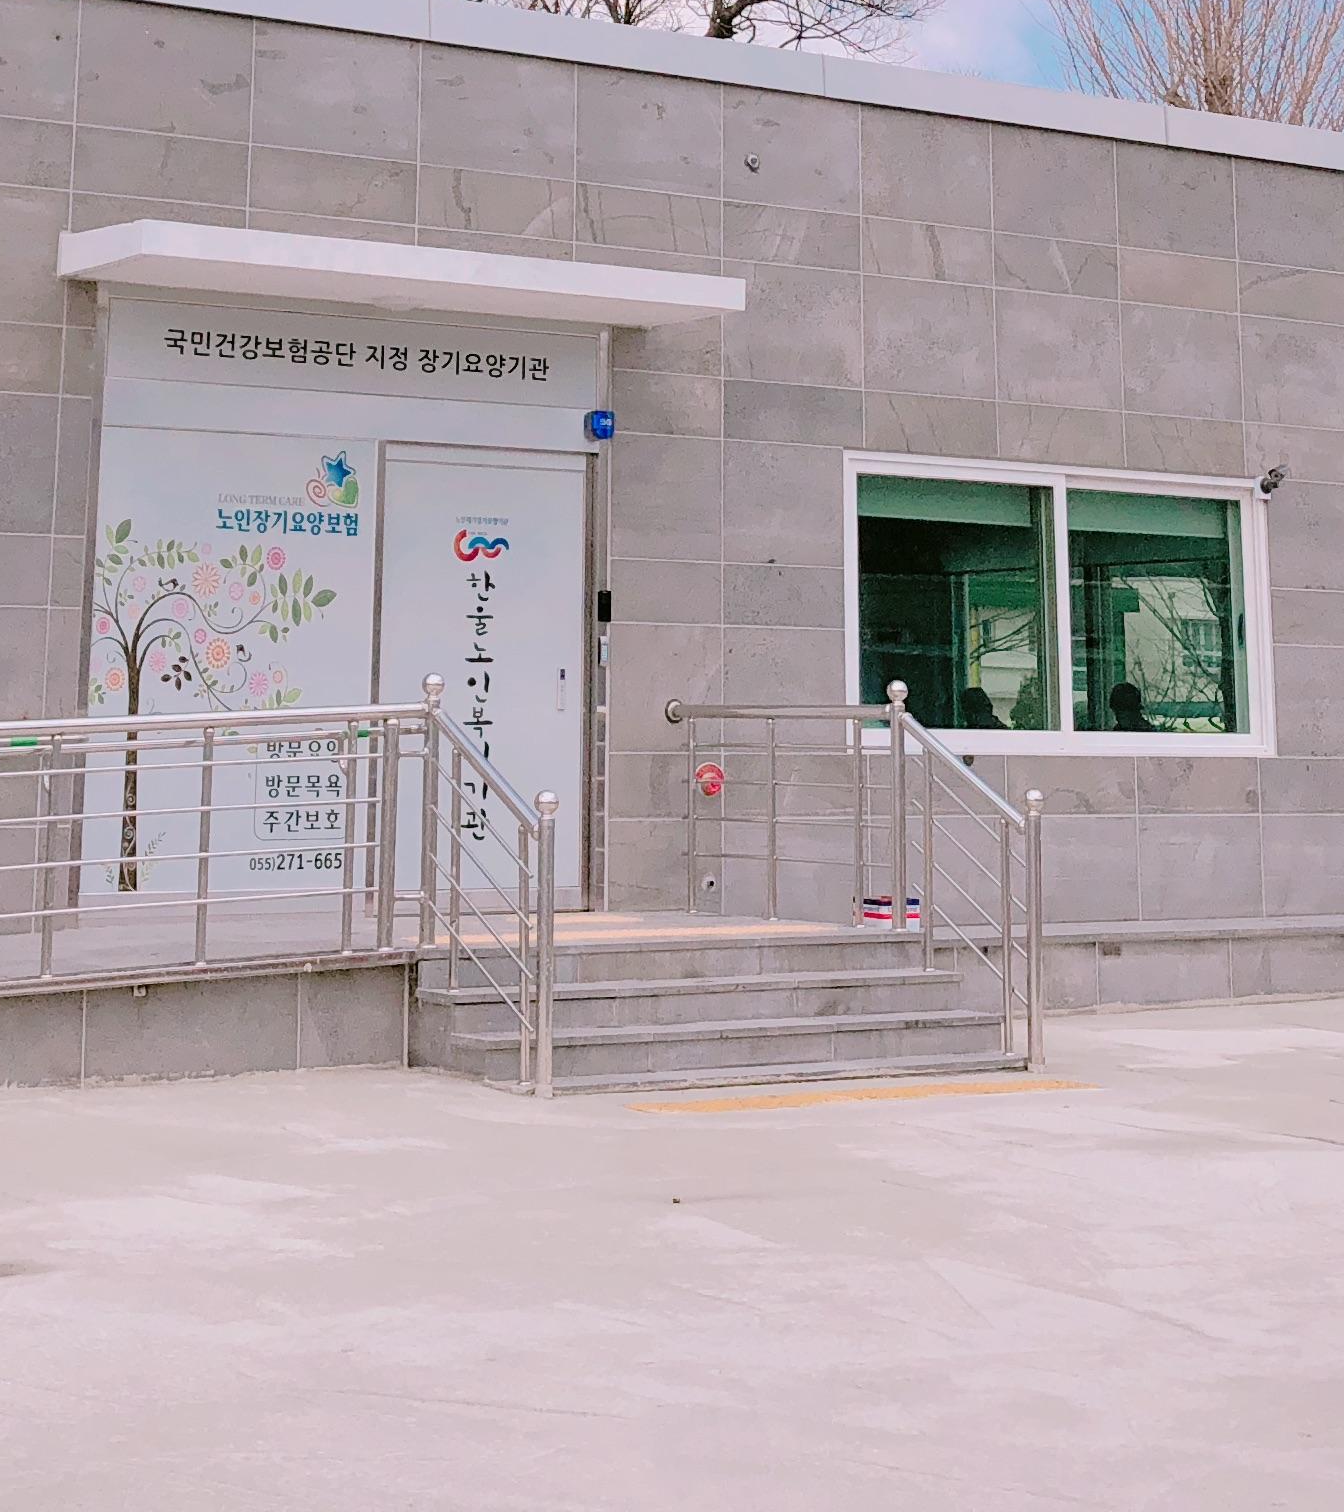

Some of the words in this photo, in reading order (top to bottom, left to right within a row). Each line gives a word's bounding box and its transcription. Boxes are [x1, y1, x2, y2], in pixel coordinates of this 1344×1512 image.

[164, 328, 356, 368] 국민건강보험공단
[365, 344, 408, 371] 지정
[418, 348, 550, 382] 장기요양기관
[218, 493, 247, 504] LONG
[248, 494, 277, 505] TERM
[278, 496, 305, 507] CARE
[216, 508, 359, 536] 노인장기요양보험
[265, 774, 343, 798] 방문목욕
[262, 809, 342, 833] 주간보호
[249, 853, 343, 871] 055)271-665
